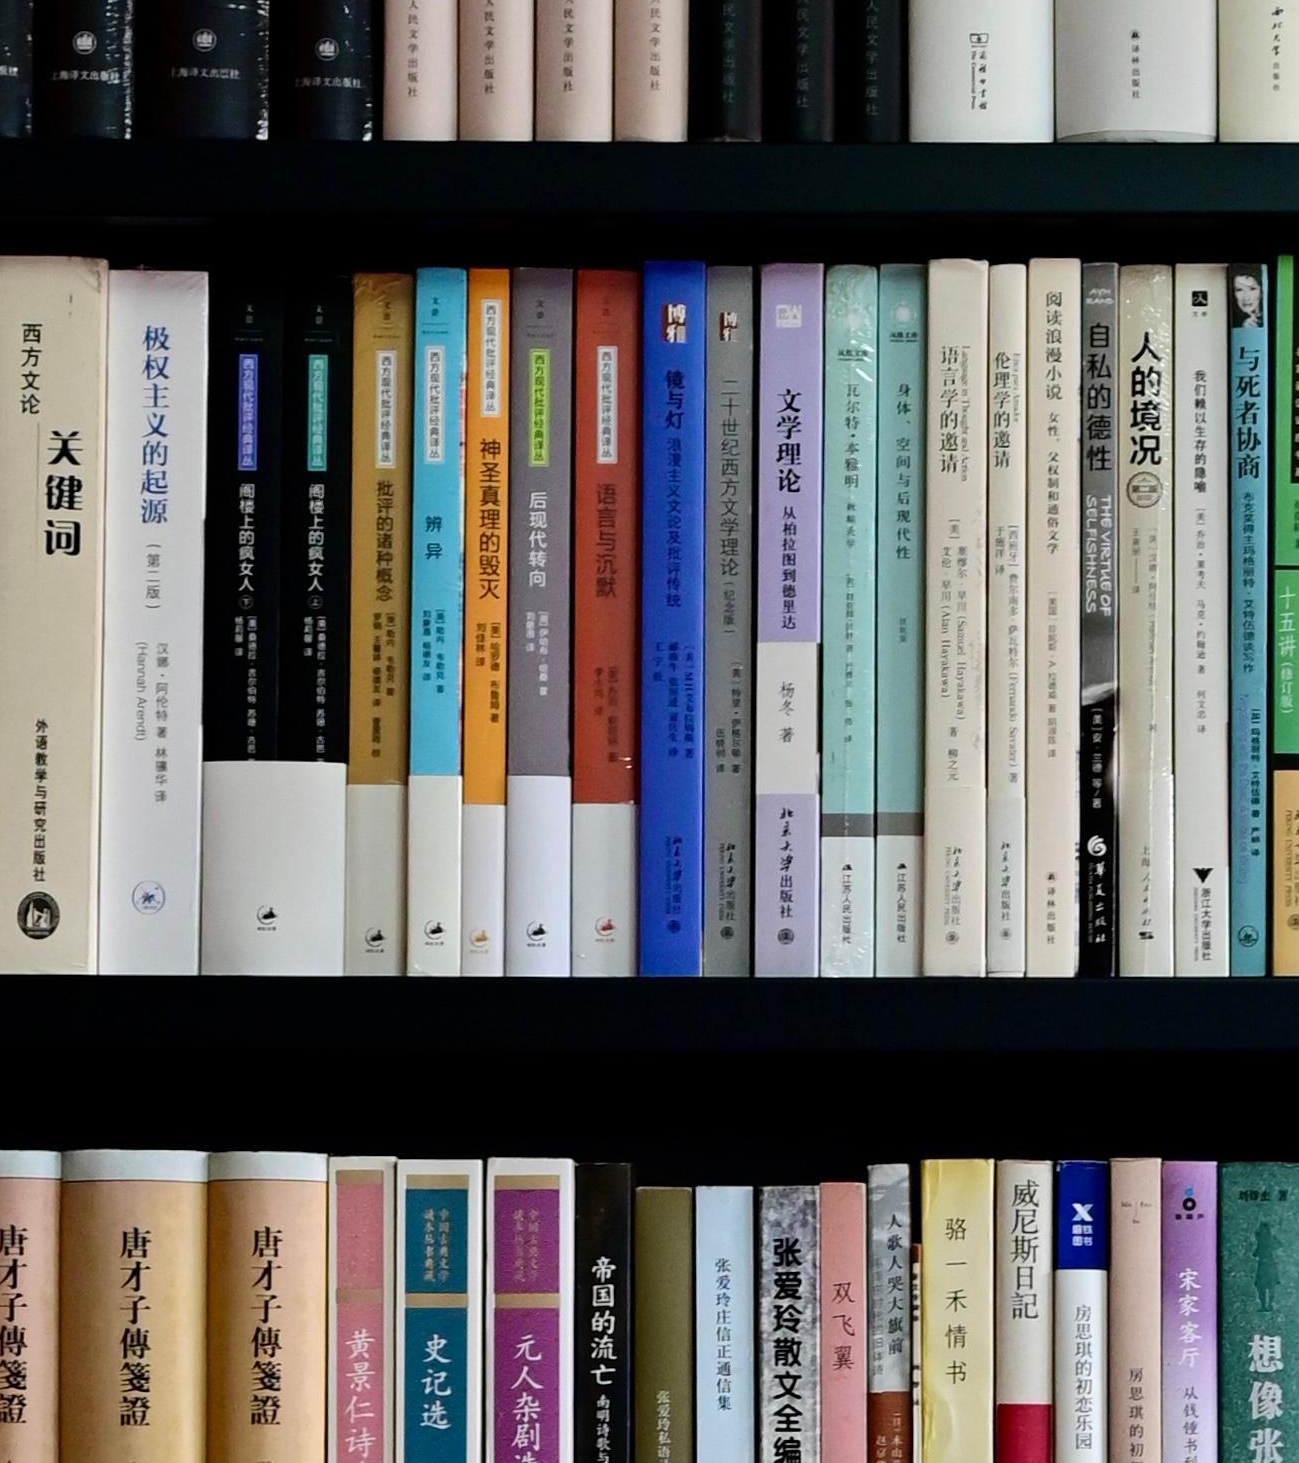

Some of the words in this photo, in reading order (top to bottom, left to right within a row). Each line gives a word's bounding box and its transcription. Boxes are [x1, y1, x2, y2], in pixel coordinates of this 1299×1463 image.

[407, 0, 419, 98] 人民文学出版社
[21, 323, 42, 415] 西方文论
[141, 325, 169, 524] 极权主义的起源
[940, 345, 959, 474] 语言学的邀请
[1086, 322, 1112, 472] 自私的德性
[1130, 331, 1162, 466] 人的境况
[1193, 369, 1207, 494] 我们赖以生存的隐喻
[1237, 346, 1261, 479] 与死者协商
[45, 430, 83, 557] 关键词
[777, 388, 802, 493] 文学理论
[528, 491, 548, 588] 后现代转向
[781, 505, 797, 630] 从柏拉图到德里达
[33, 718, 48, 883] 外语教学与研究出版社
[945, 1217, 967, 1385] 骆一禾情书
[1012, 1179, 1039, 1320] 威尼斯日記
[120, 1226, 151, 1427] 唐才子傳箋證
[251, 1225, 282, 1426] 唐才子傳箋證
[421, 1333, 452, 1430] 史记选
[591, 1256, 616, 1386] 帝国的流亡
[1075, 1304, 1093, 1450] 房思琪的初恋乐园
